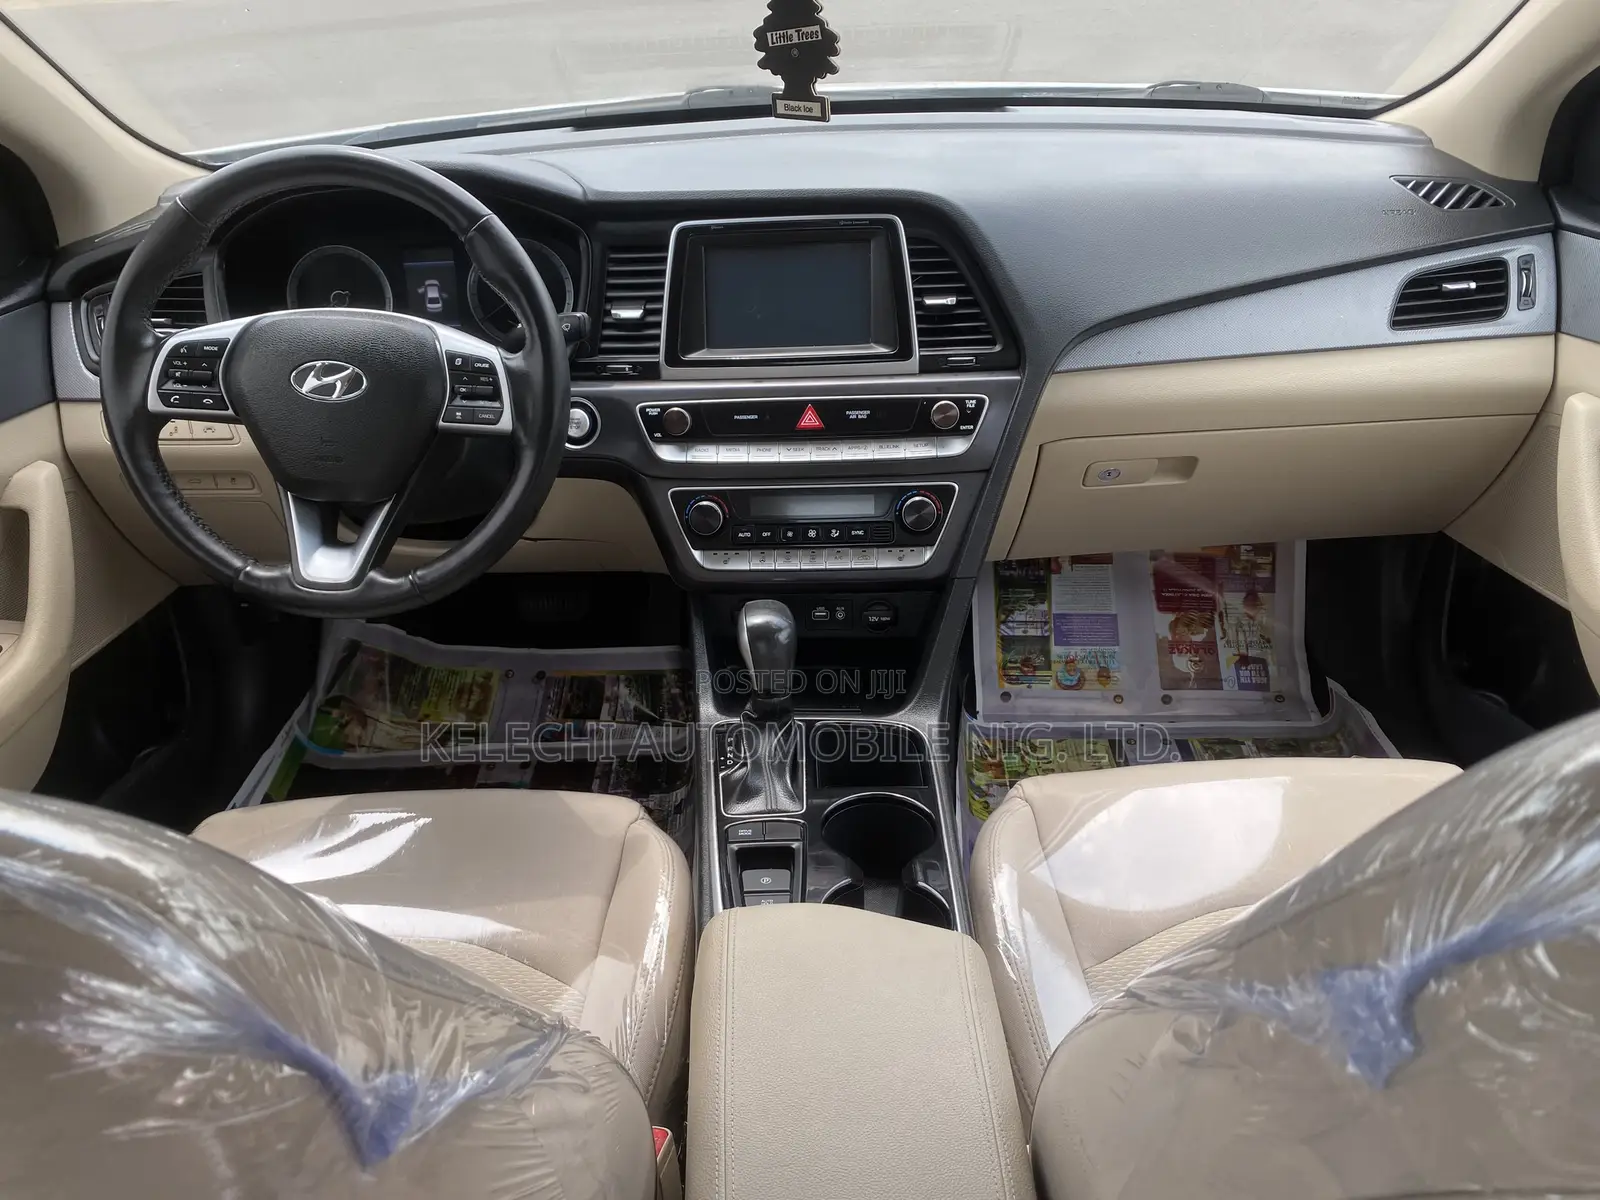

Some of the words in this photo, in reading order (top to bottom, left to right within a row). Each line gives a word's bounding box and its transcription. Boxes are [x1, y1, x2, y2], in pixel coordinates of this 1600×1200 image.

[770, 30, 794, 45] Little
[795, 28, 820, 42] Trees
[784, 103, 802, 112] Black
[803, 104, 814, 113] Ice
